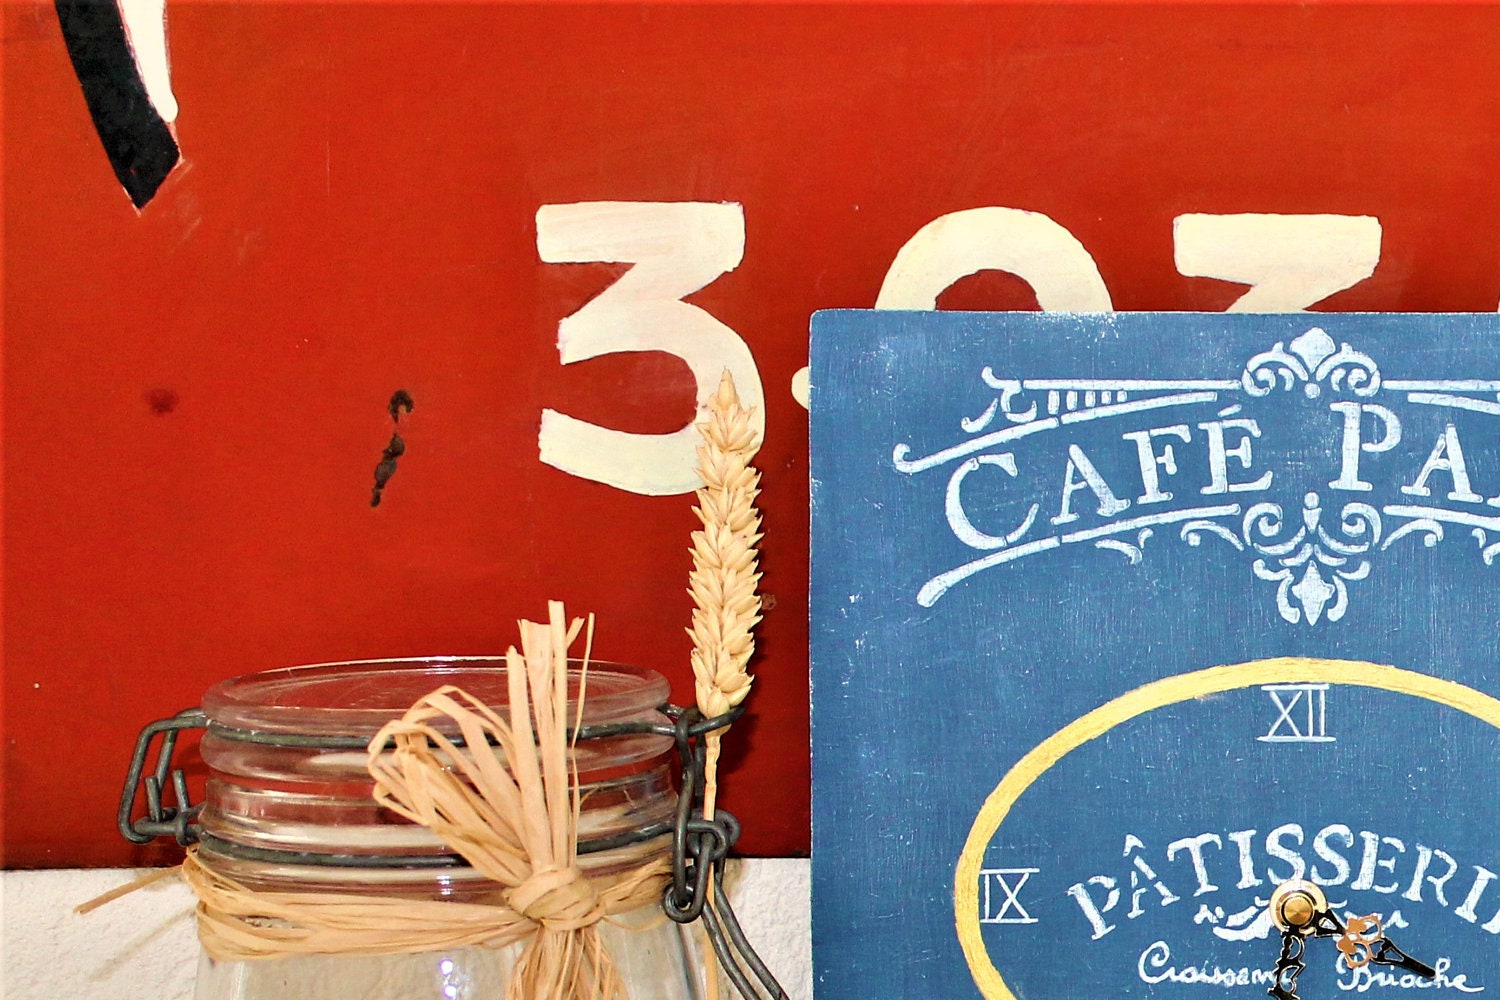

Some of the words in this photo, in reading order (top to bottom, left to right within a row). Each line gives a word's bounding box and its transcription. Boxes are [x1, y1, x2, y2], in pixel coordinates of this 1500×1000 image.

[944, 403, 1274, 552] CAFÉ
[1256, 683, 1336, 742] XII
[979, 867, 1039, 923] IX
[1138, 941, 1296, 986] Croissan
